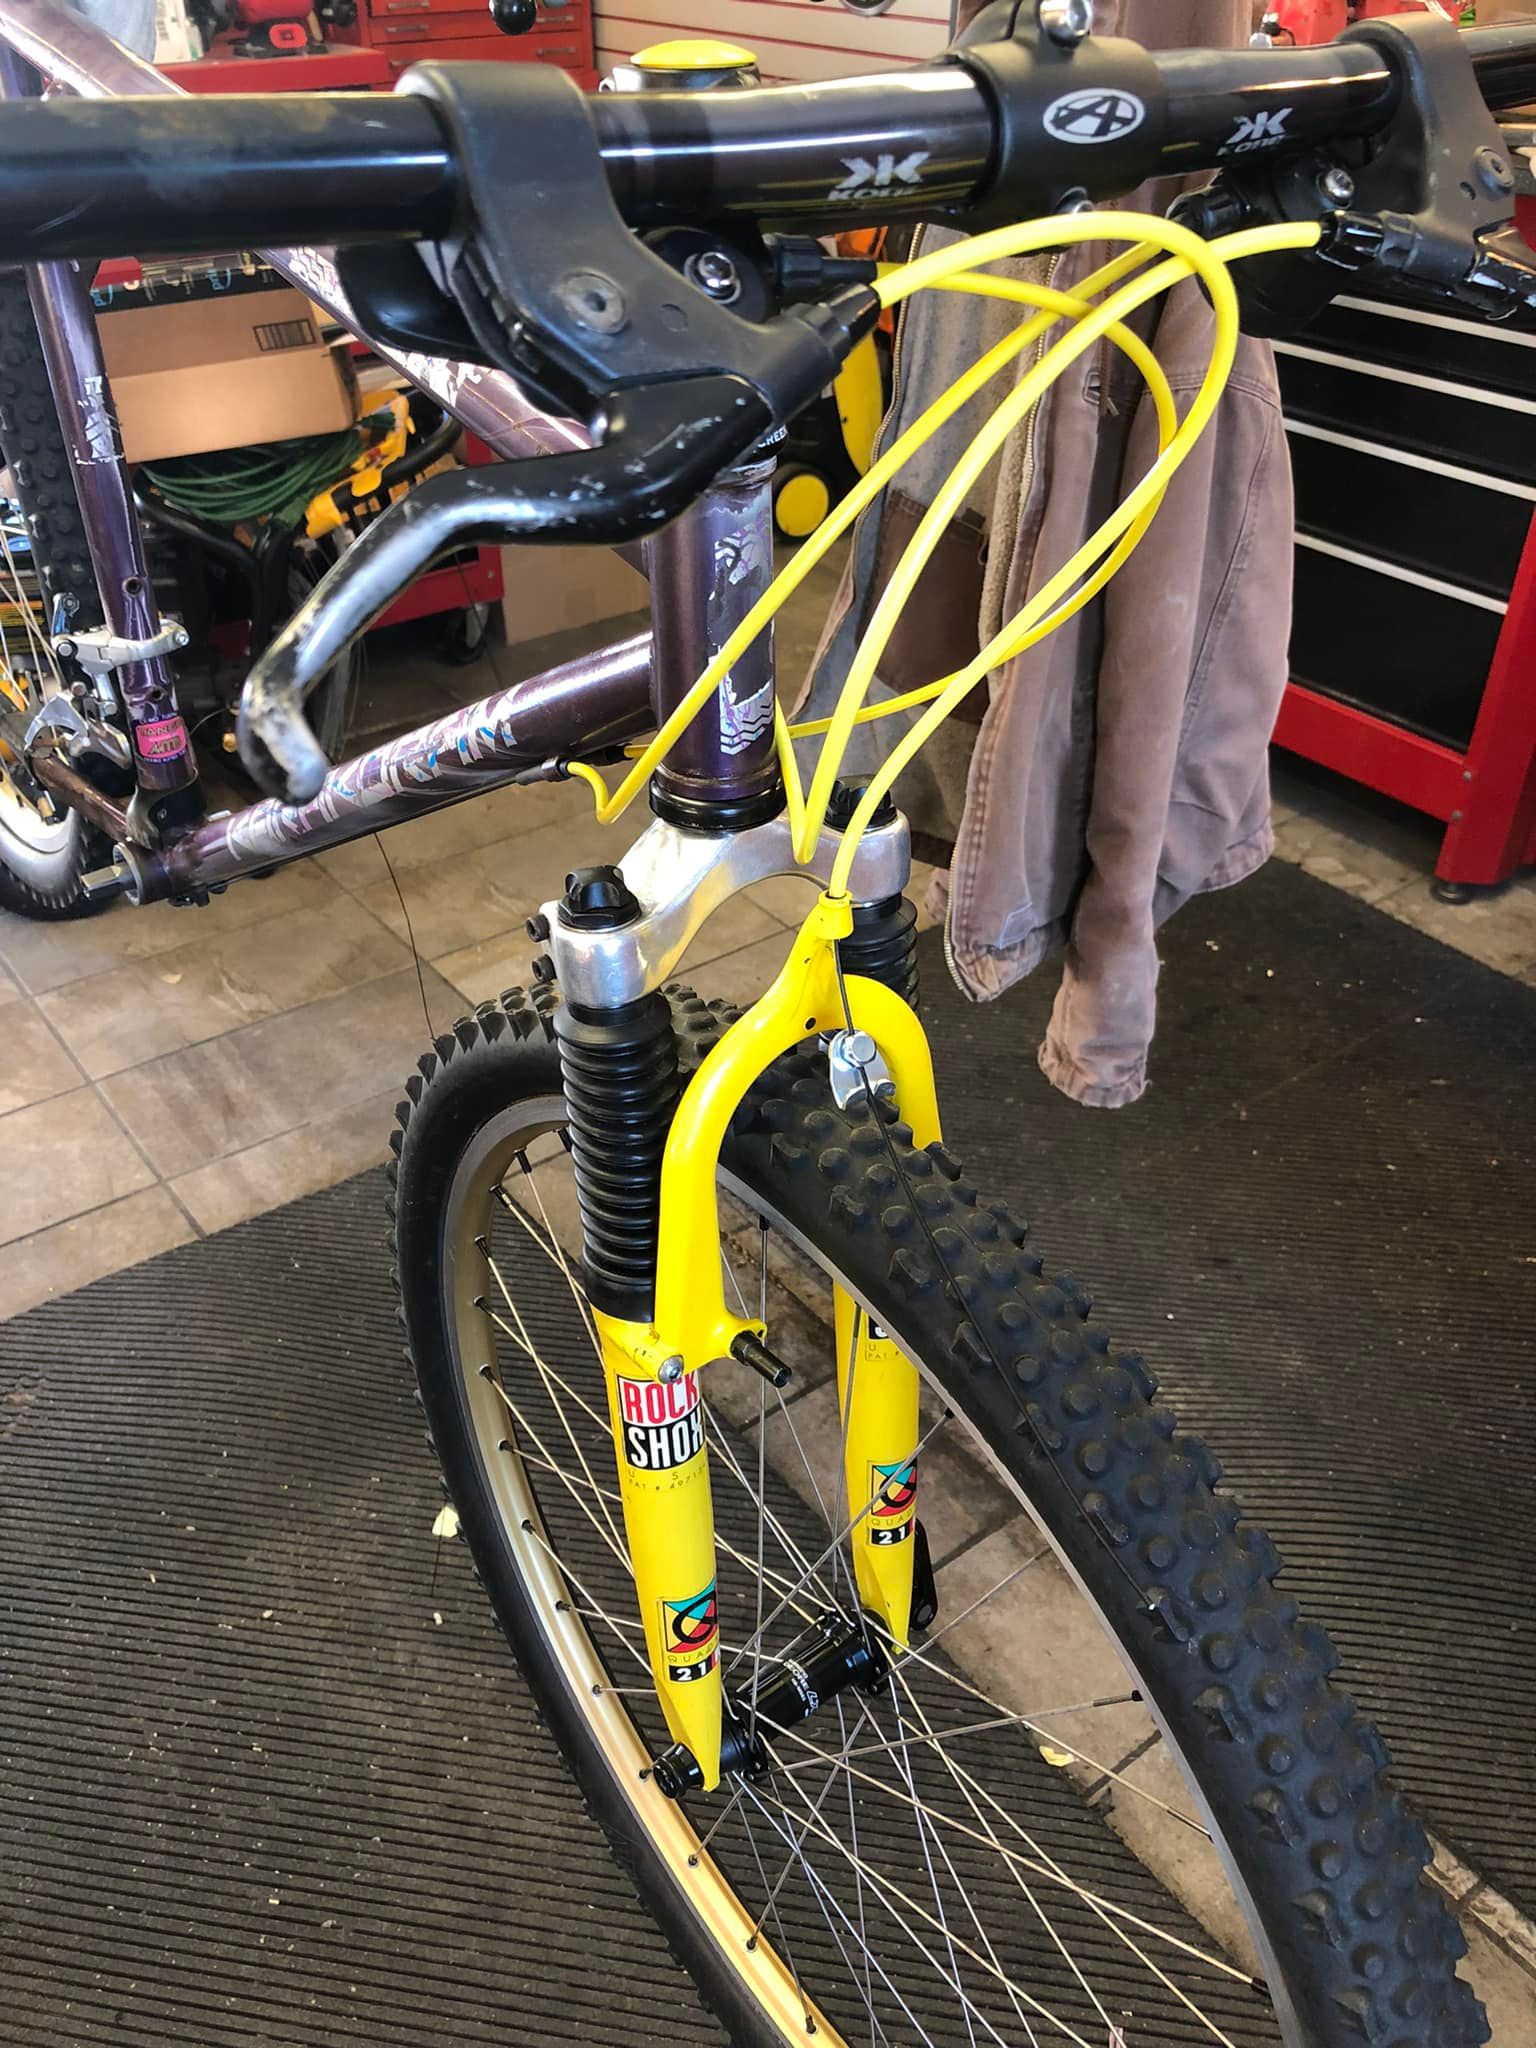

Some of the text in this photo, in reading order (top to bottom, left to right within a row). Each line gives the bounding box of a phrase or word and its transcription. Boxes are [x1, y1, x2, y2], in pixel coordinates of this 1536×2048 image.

[623, 1370, 698, 1424] ROCK
[628, 1405, 703, 1469] SHOX
[872, 1508, 914, 1526] QUAD
[878, 1526, 905, 1545] 21
[668, 1639, 715, 1663] QUAD
[676, 1661, 707, 1681] 21
